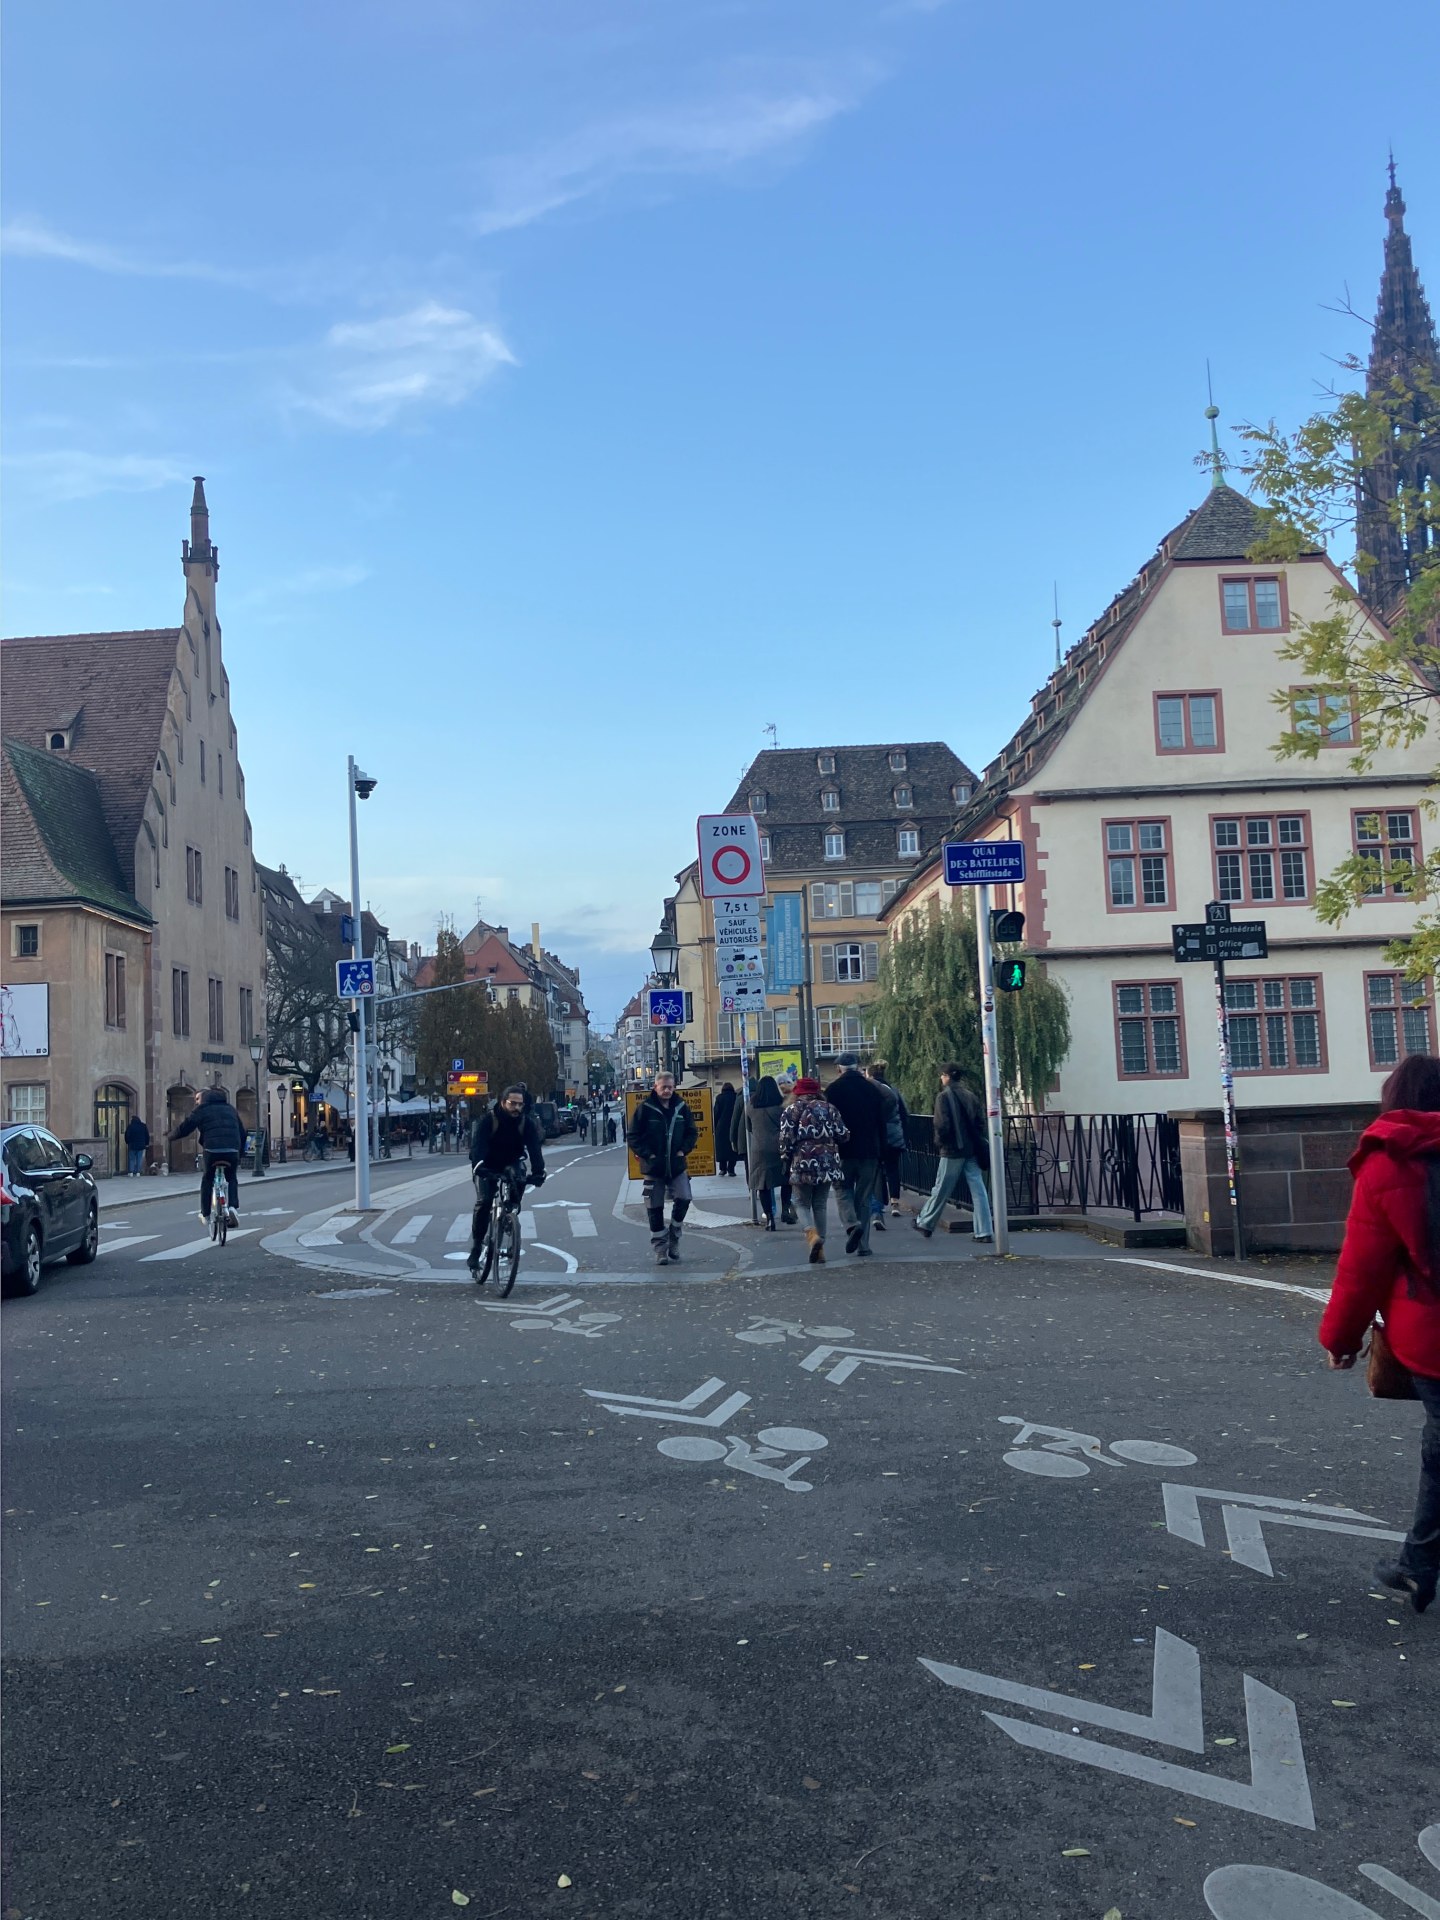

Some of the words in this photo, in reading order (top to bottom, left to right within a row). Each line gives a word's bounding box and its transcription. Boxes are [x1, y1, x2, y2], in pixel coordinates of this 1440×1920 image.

[713, 825, 747, 836] ZONE
[972, 847, 996, 857] QUAI
[950, 860, 968, 868] DES
[970, 858, 1020, 868] BATELIERS
[724, 902, 741, 914] 7,5
[743, 903, 748, 912] t
[728, 919, 747, 927] SAUF
[719, 926, 757, 936] VÉHICULES
[1219, 925, 1262, 934] Cathédrale
[719, 935, 758, 944] AUTORISÉS
[1218, 940, 1242, 948] Office
[1231, 949, 1264, 957] toue
[455, 1061, 462, 1070] P
